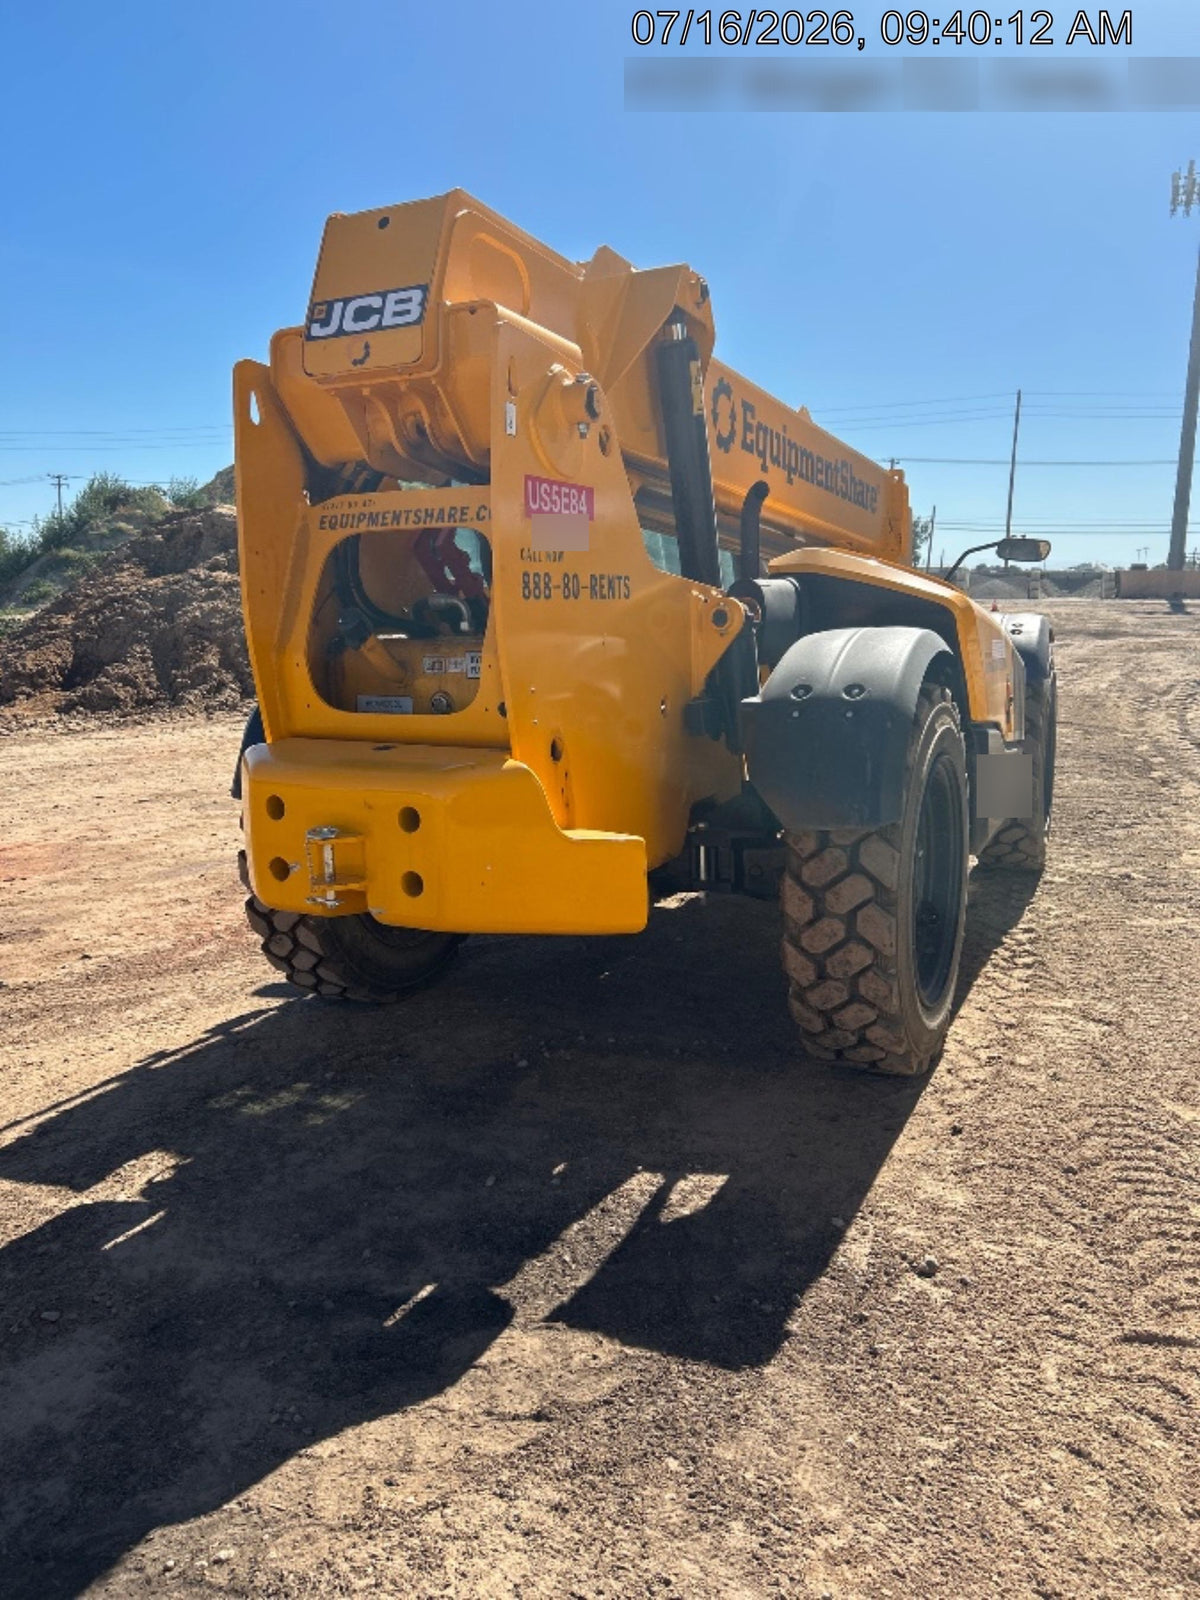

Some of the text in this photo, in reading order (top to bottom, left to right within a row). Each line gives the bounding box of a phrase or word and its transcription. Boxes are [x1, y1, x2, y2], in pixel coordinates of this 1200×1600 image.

[310, 289, 424, 337] JCB
[741, 399, 877, 513] EquipmentShare
[527, 480, 588, 515] US5E84
[522, 571, 630, 600] 888-80-RENTS
